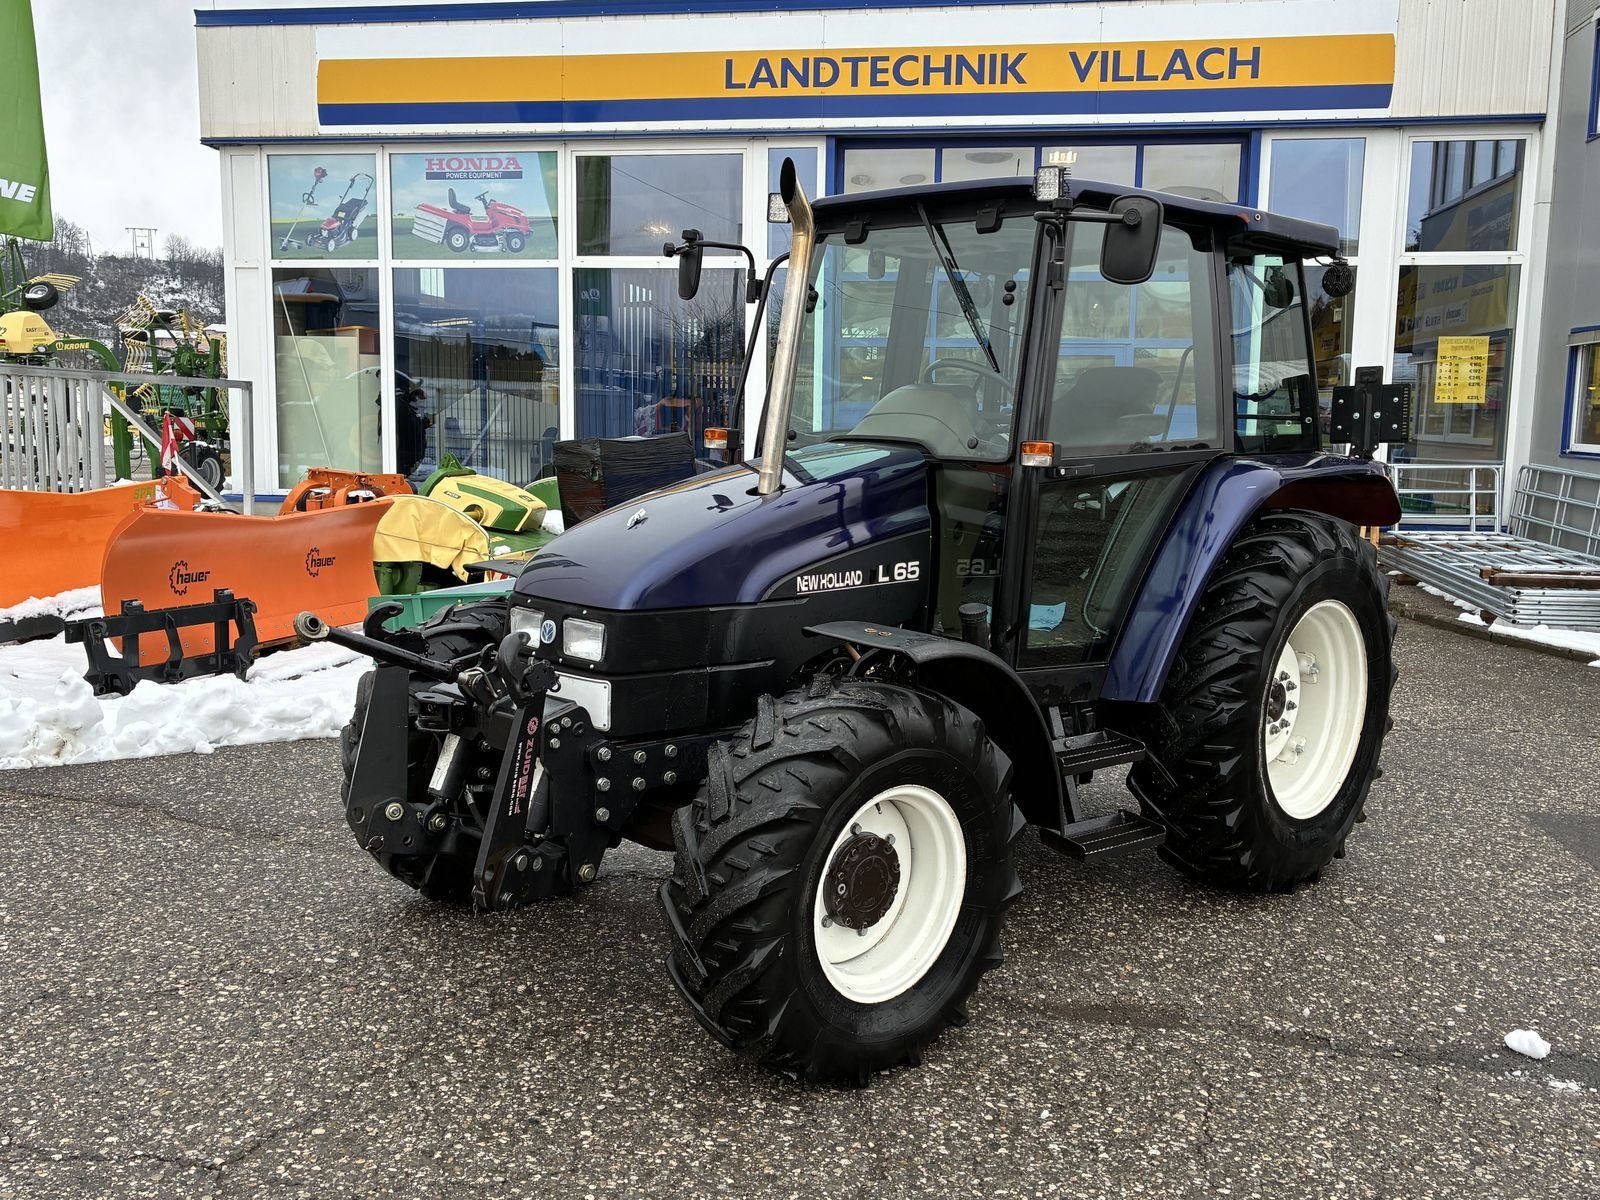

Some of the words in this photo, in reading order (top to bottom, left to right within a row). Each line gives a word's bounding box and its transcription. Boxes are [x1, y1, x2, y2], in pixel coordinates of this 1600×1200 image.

[725, 52, 1028, 89] LANDTECHNIK
[1068, 46, 1261, 83] VILLACH
[425, 157, 523, 170] HONDA
[469, 171, 502, 179] EQUIPMENT
[63, 341, 90, 350] KRONE
[310, 555, 336, 568] hauer
[176, 569, 211, 585] hauer
[796, 574, 820, 592] NEW
[820, 570, 863, 589] HOLLAND
[878, 564, 889, 582] L
[893, 561, 920, 580] 65
